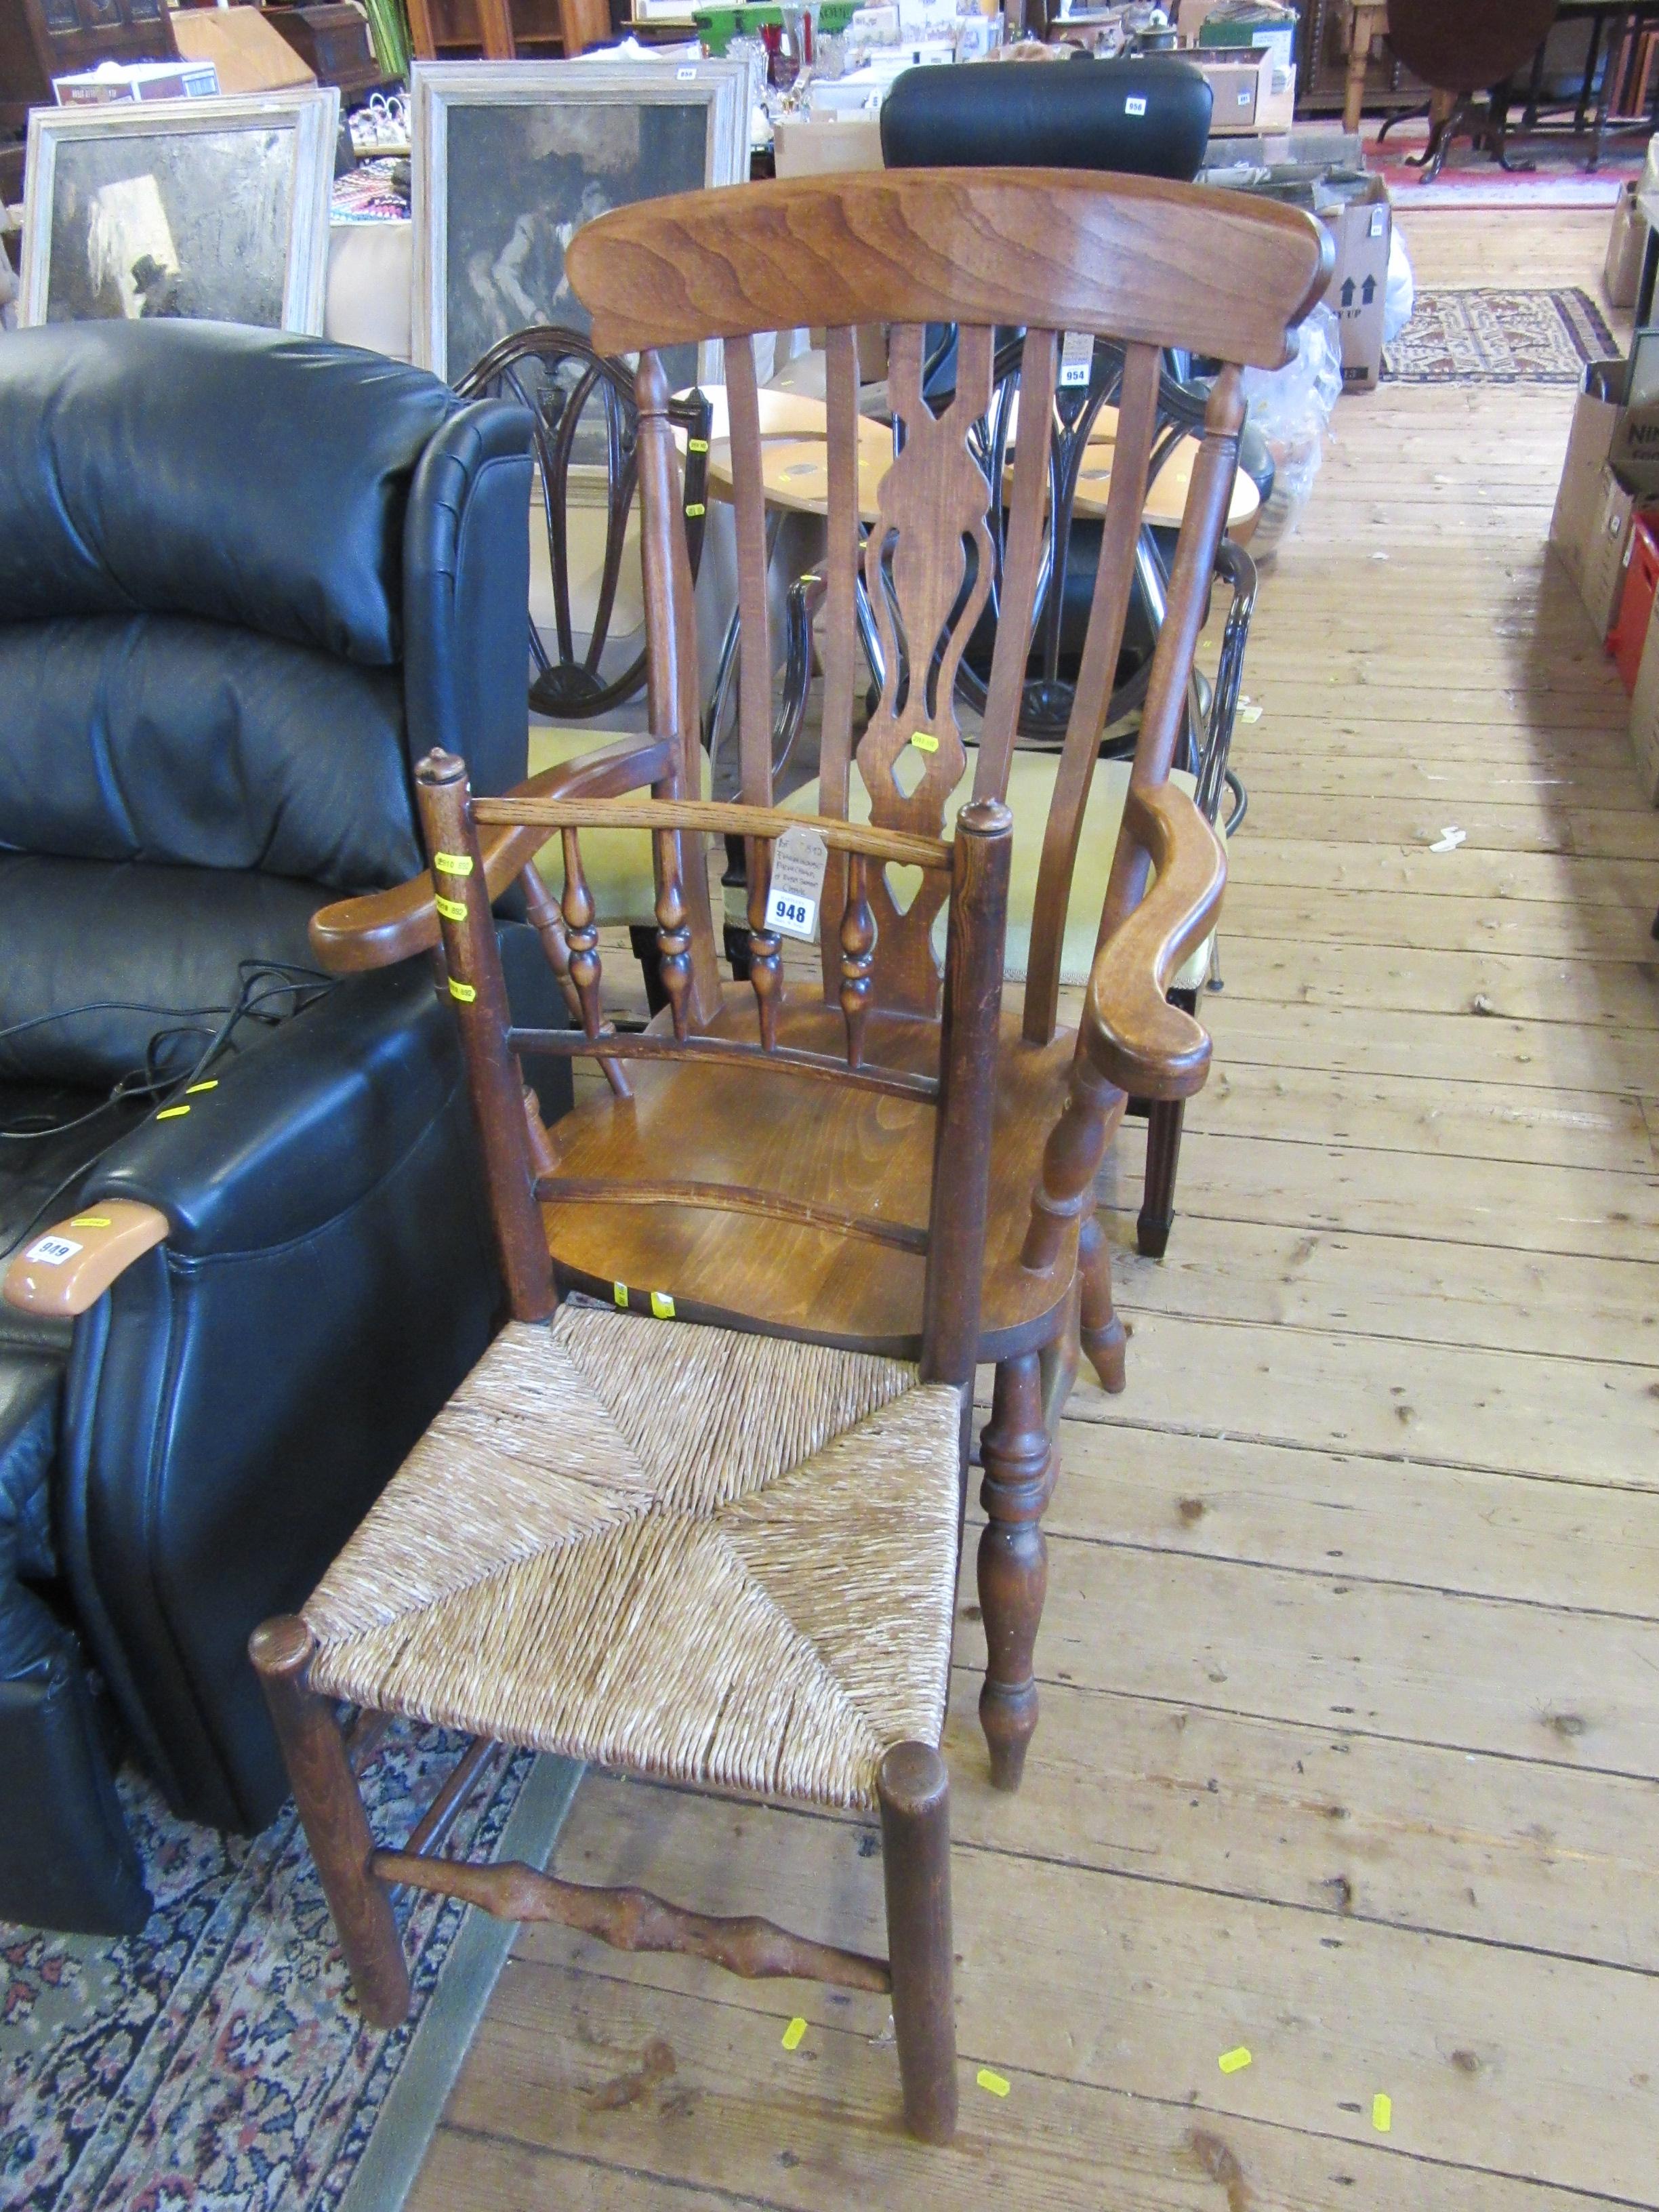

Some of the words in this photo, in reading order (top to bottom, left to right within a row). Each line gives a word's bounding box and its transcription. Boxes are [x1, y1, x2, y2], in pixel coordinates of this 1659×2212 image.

[1129, 102, 1143, 111] 956
[1067, 370, 1084, 381] 954
[776, 901, 806, 923] 948
[39, 1242, 70, 1257] 949
